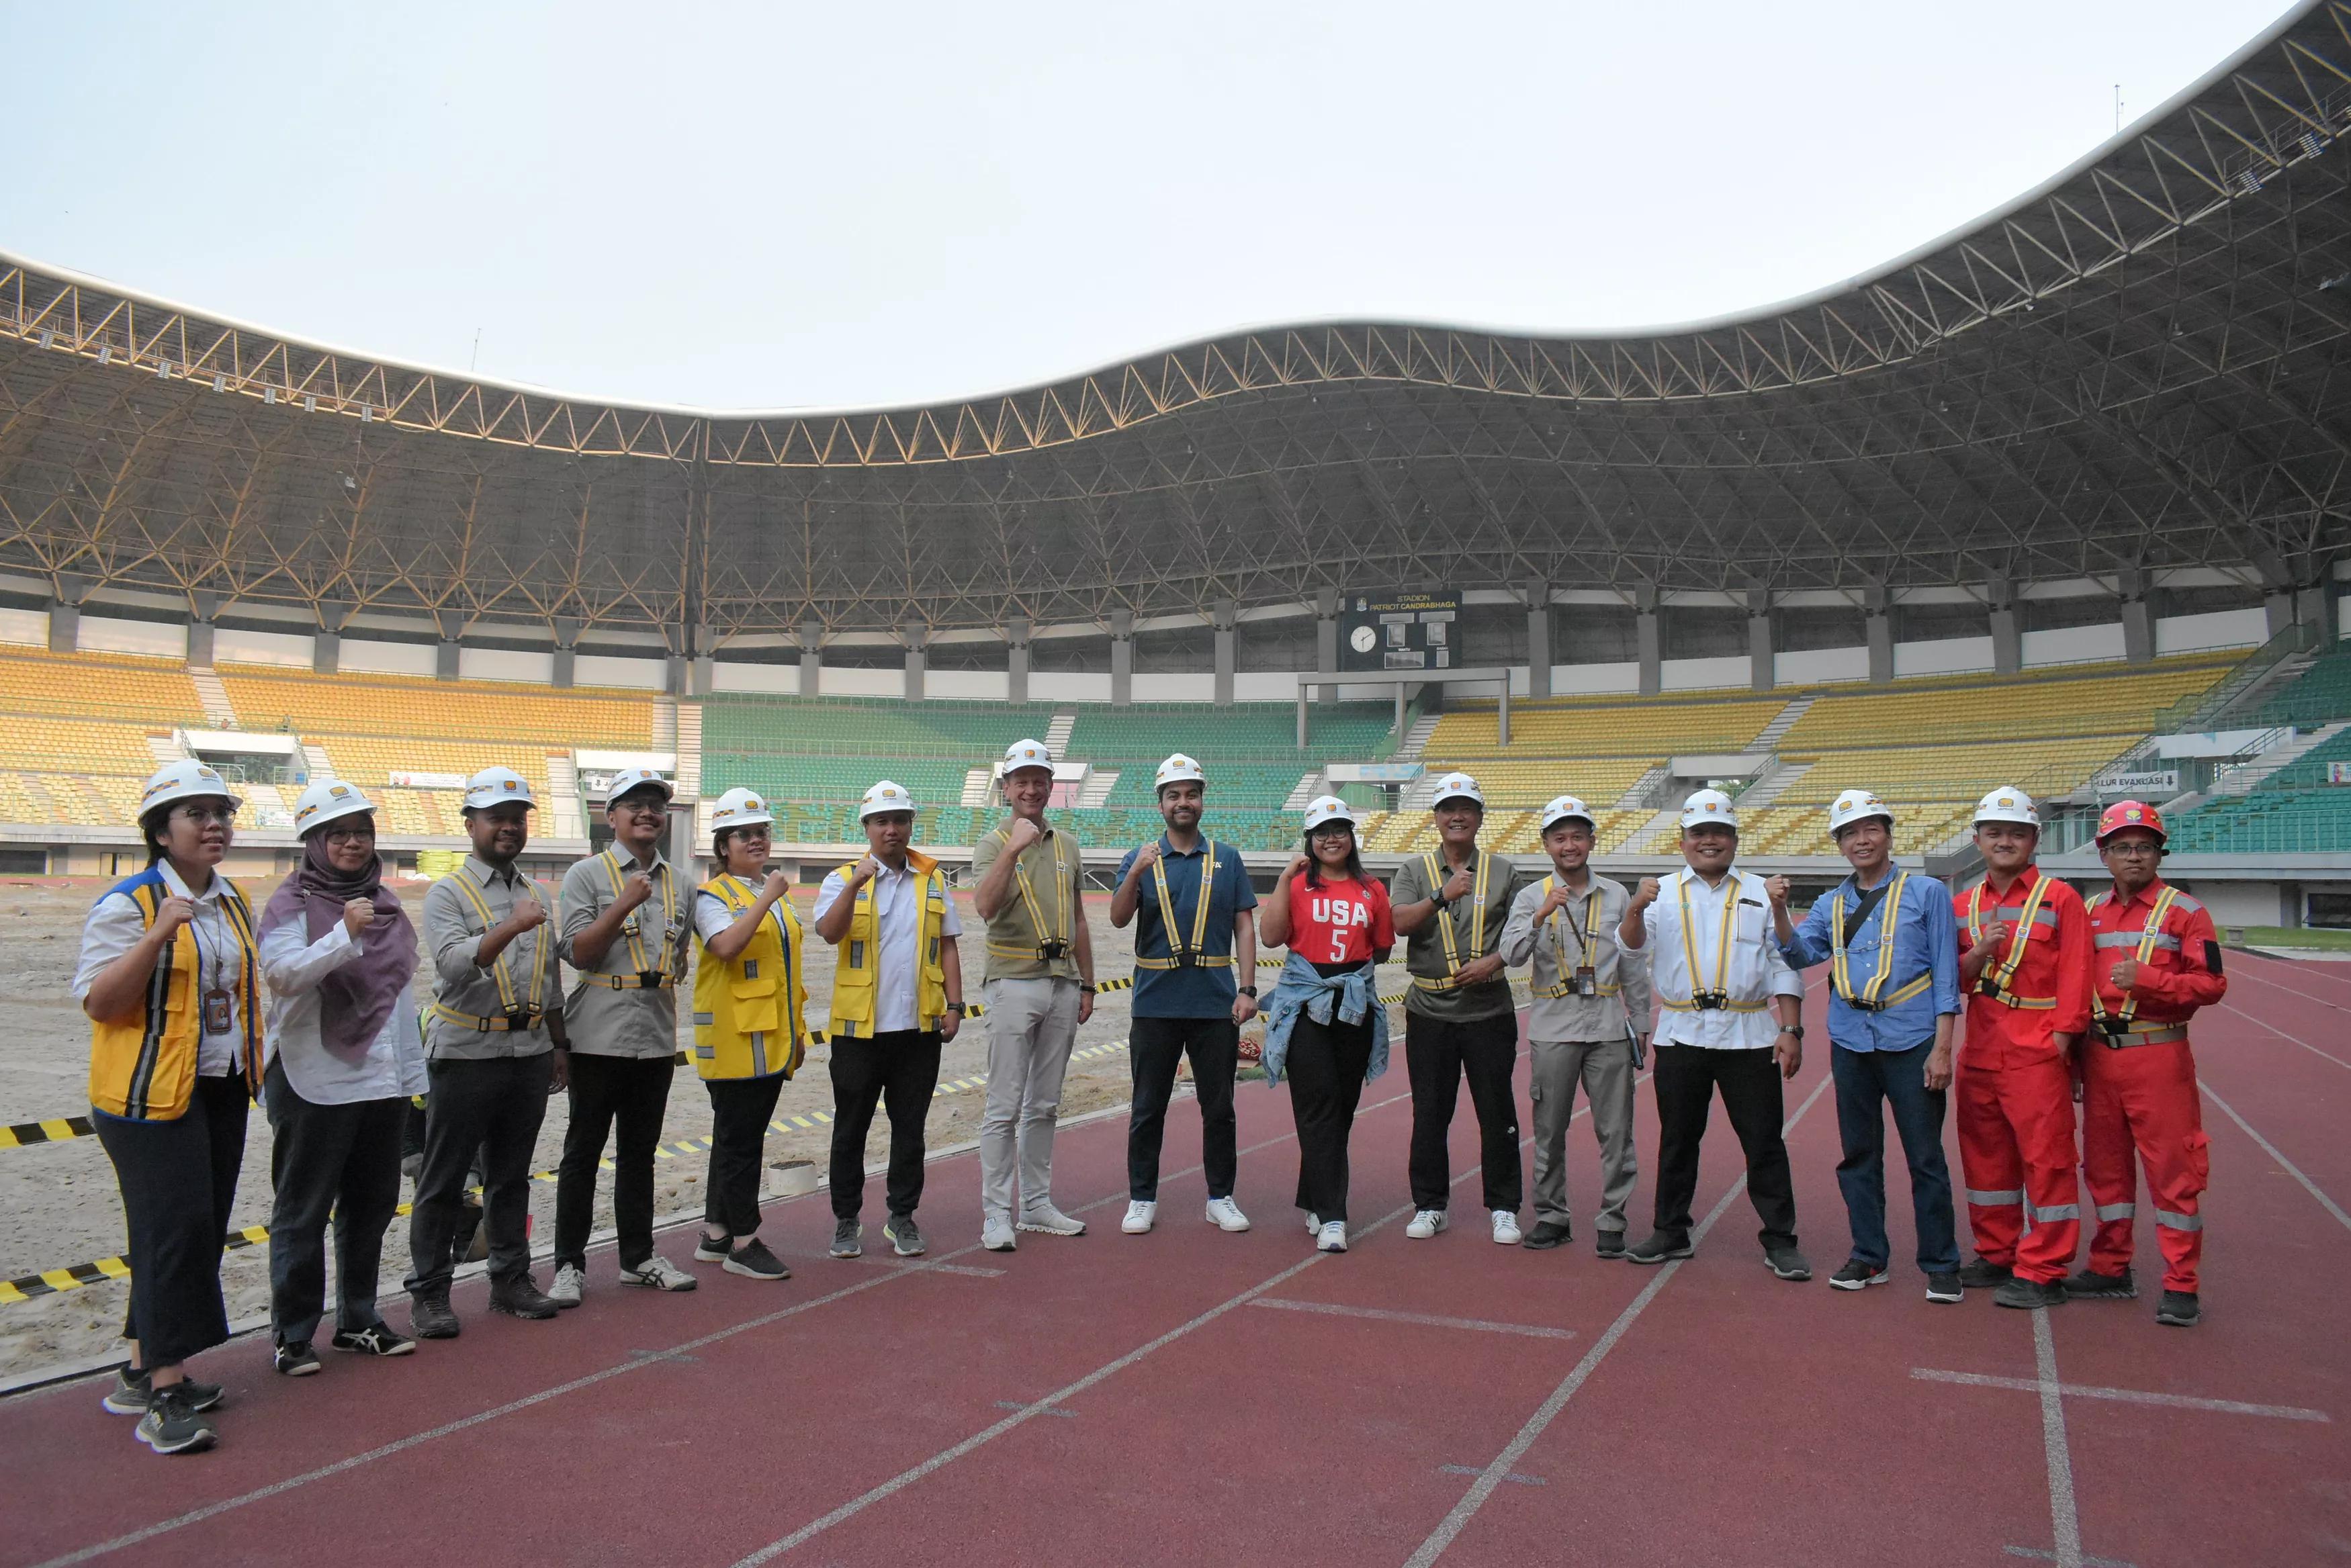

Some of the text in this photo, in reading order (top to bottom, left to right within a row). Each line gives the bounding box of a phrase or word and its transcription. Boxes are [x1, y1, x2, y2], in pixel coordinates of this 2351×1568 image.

[1397, 594, 1430, 602] STADION
[1401, 601, 1456, 610] CANDRABHAGA
[2119, 777, 2163, 786] EVAKUASI
[1313, 898, 1368, 928] USA
[1330, 929, 1347, 962] 5
